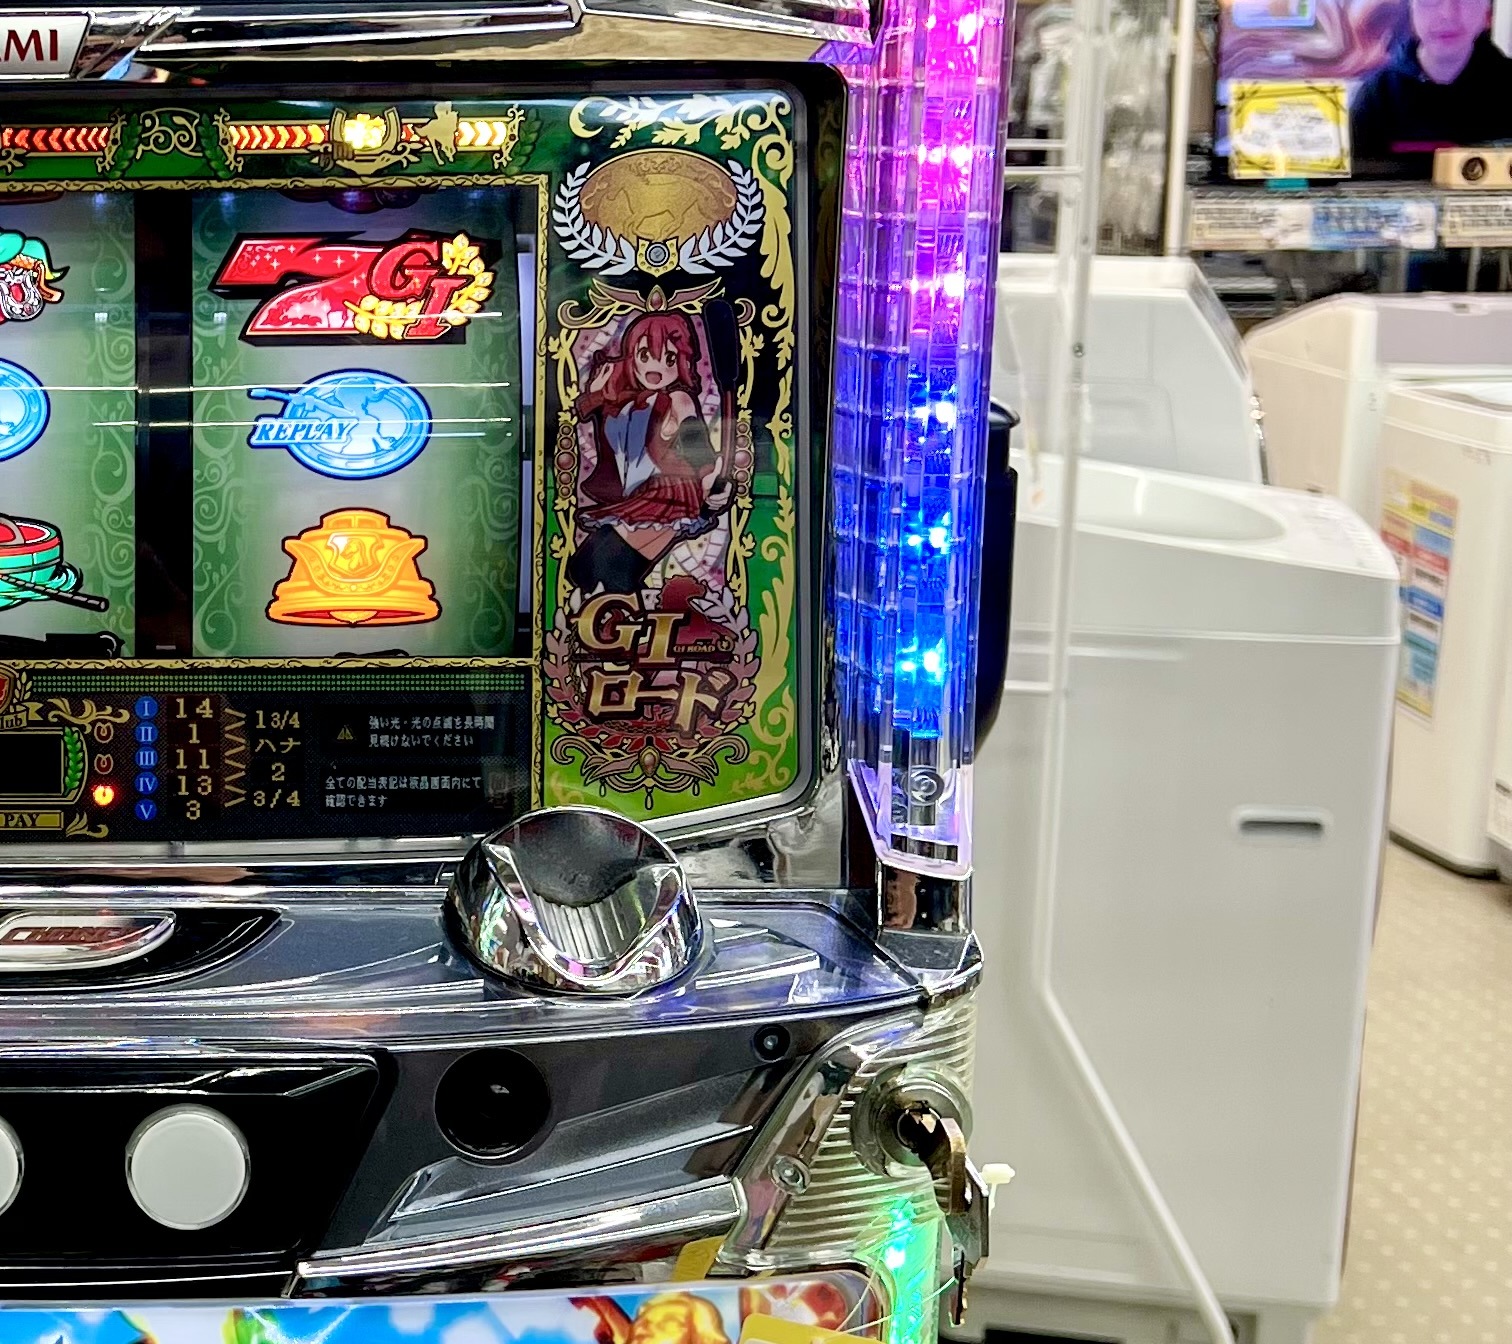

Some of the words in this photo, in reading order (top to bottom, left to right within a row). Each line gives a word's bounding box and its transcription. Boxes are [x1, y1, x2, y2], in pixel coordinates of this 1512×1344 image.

[257, 422, 353, 443] REPLAY
[175, 698, 214, 720] 14
[588, 670, 734, 734] ロード
[254, 736, 301, 754] ハナ
[368, 733, 474, 748] 見続けないでください
[176, 749, 210, 771] 11
[271, 762, 285, 781] 2
[176, 775, 213, 797] 13
[324, 775, 482, 790] 全ての配当表記は液晶画面内にて
[185, 800, 201, 821] 3
[324, 793, 389, 808] 確認できます
[3, 813, 39, 827] PAY
